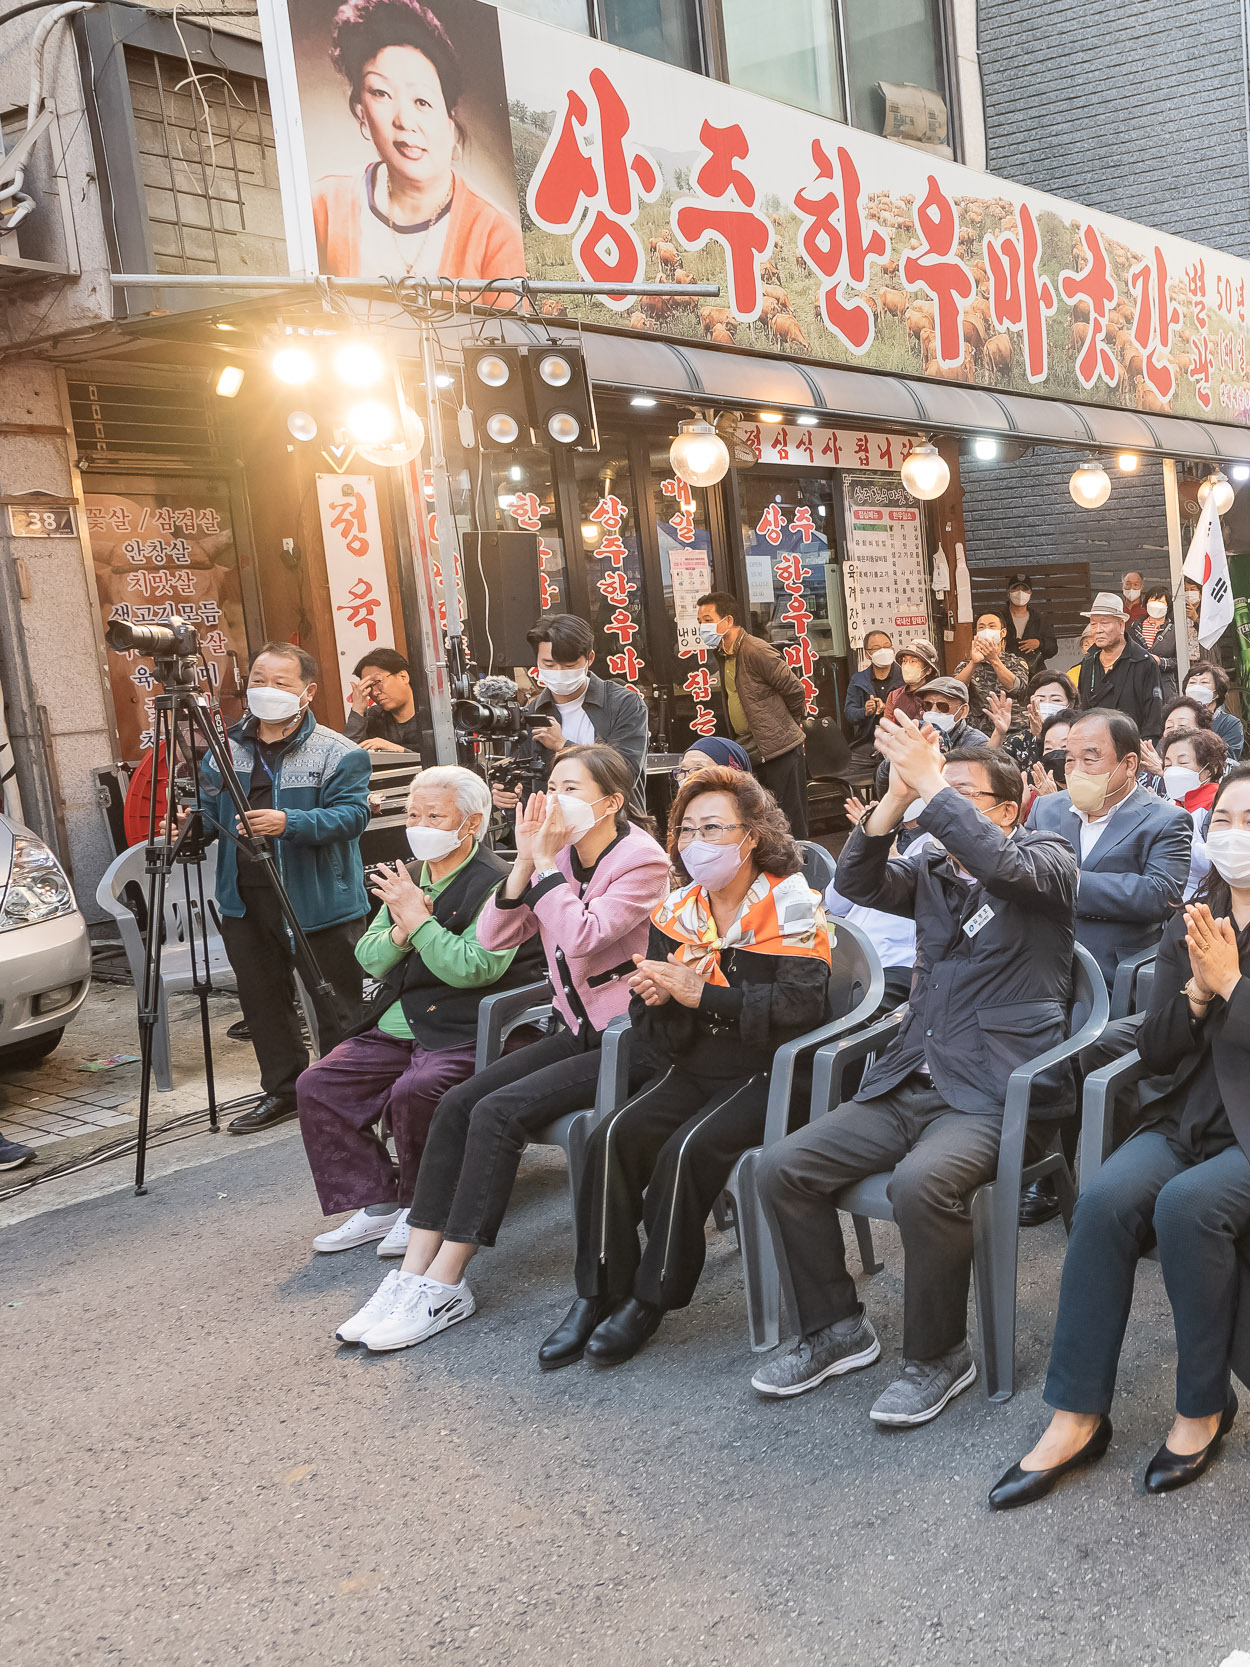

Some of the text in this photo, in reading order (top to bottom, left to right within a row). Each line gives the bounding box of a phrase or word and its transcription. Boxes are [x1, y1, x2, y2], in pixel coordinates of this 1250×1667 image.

[1217, 275, 1245, 323] 50년
[28, 512, 57, 530] 38
[154, 508, 220, 533] 삼겹살
[756, 503, 816, 544] 상주
[124, 540, 192, 565] 안창살
[128, 571, 195, 596] 치맛살
[590, 494, 645, 699] 상주한우마
[131, 663, 220, 691] 육미
[308, 771, 321, 779] K2
